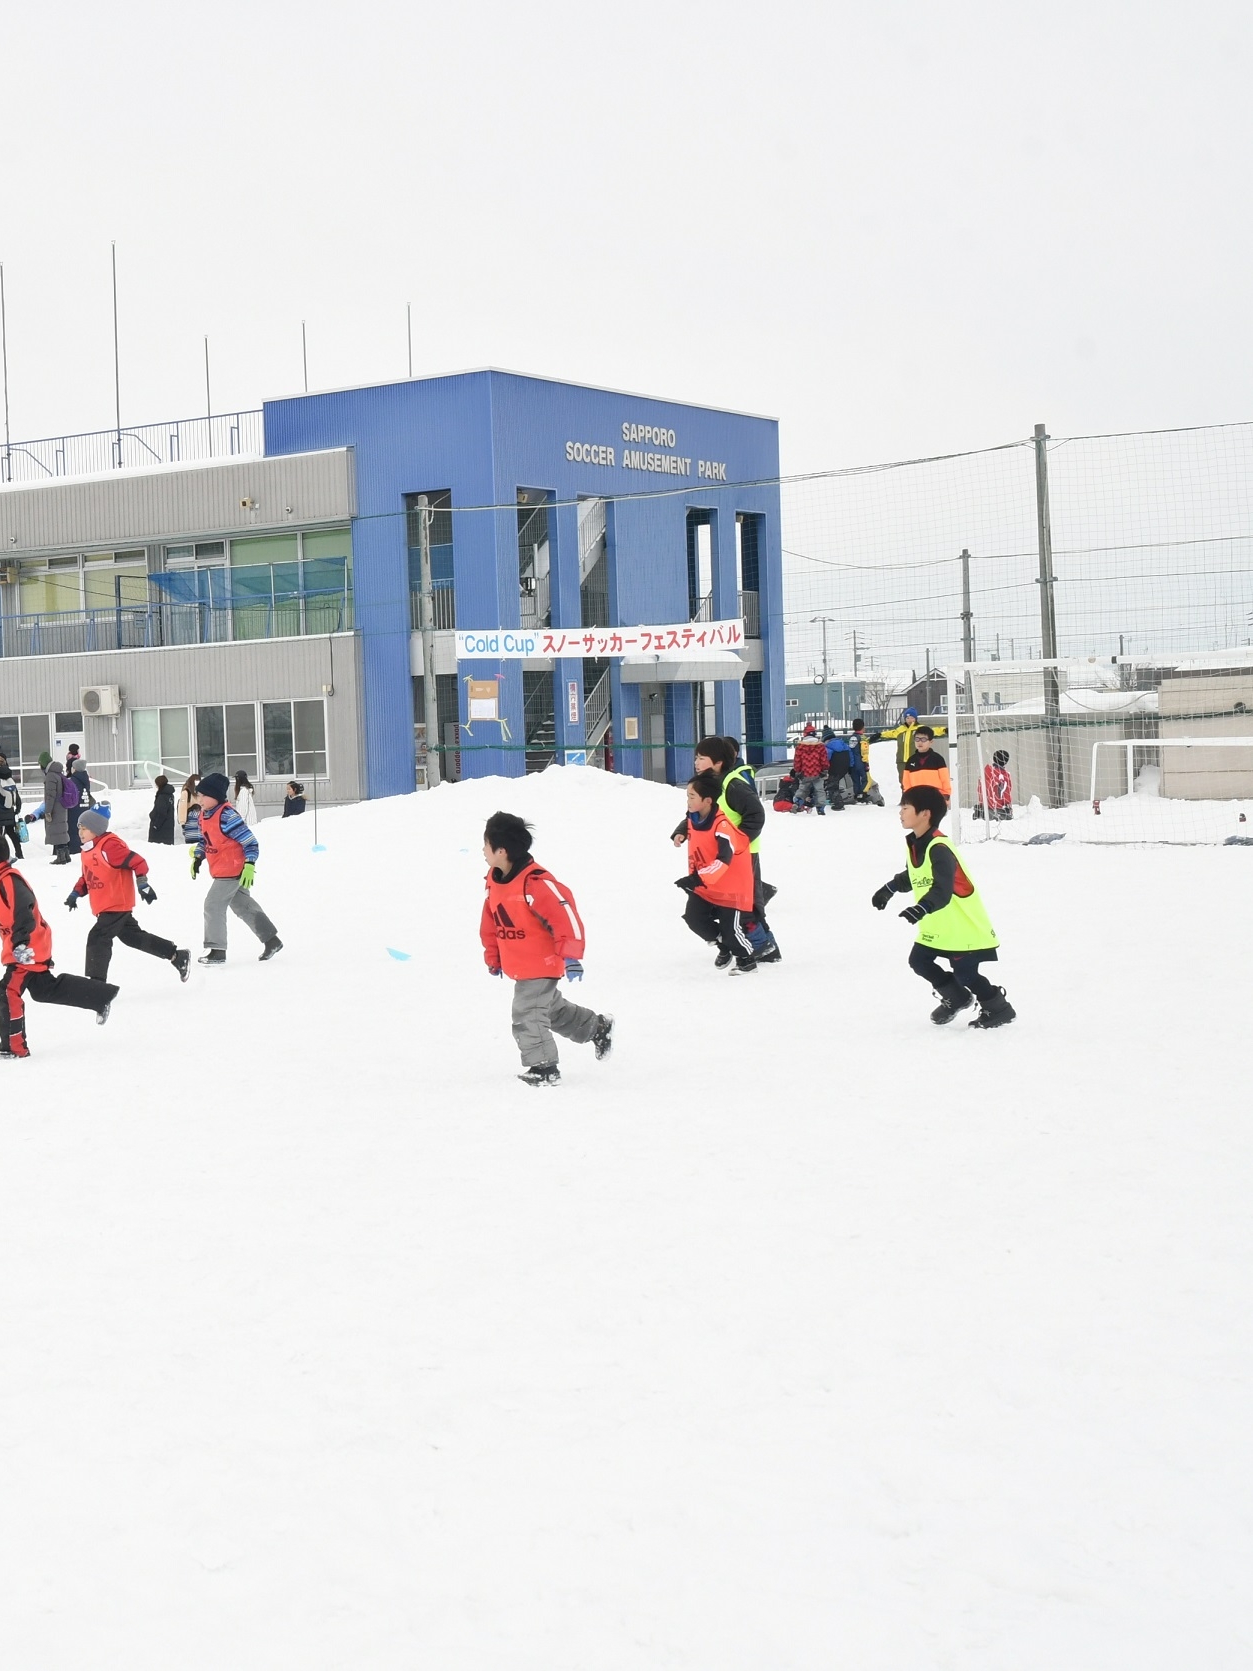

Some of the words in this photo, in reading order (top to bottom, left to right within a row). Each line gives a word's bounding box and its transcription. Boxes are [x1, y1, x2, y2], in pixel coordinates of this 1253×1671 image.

[622, 422, 676, 448] SAPPORO
[565, 441, 615, 466] SOCCER
[622, 450, 691, 476] AMUSEMENT
[698, 460, 727, 481] PARK
[542, 624, 741, 654] スノーサッカーフェスティバル
